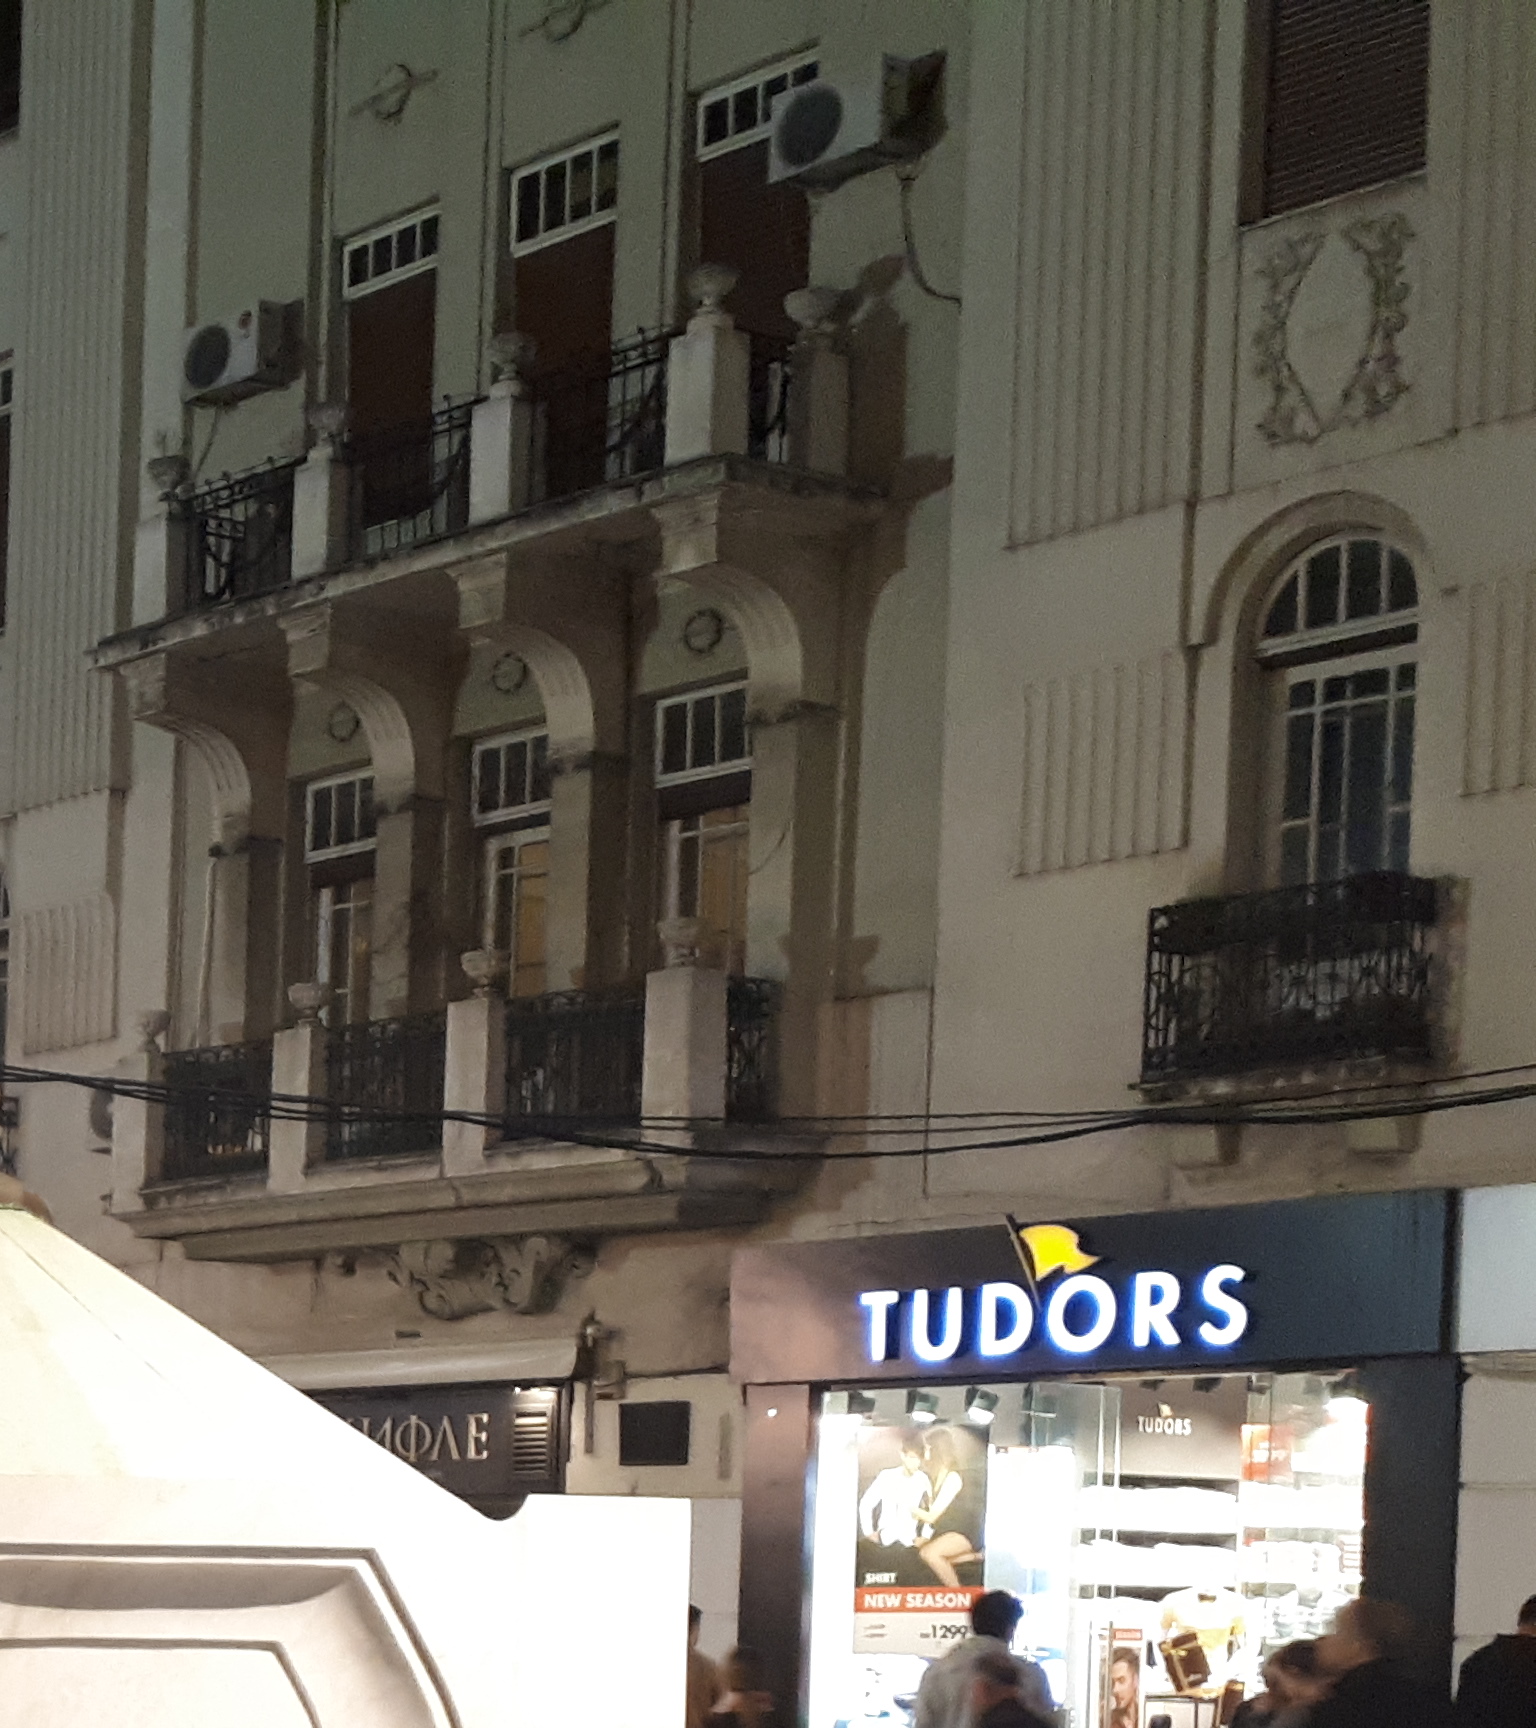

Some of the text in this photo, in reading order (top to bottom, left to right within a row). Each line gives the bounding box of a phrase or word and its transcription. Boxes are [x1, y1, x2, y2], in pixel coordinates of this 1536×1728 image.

[859, 1264, 1249, 1363] TUDORS
[1137, 1415, 1192, 1436] TUDORS
[864, 1592, 971, 1608] NEW SEASON
[931, 1624, 967, 1639] 1299
